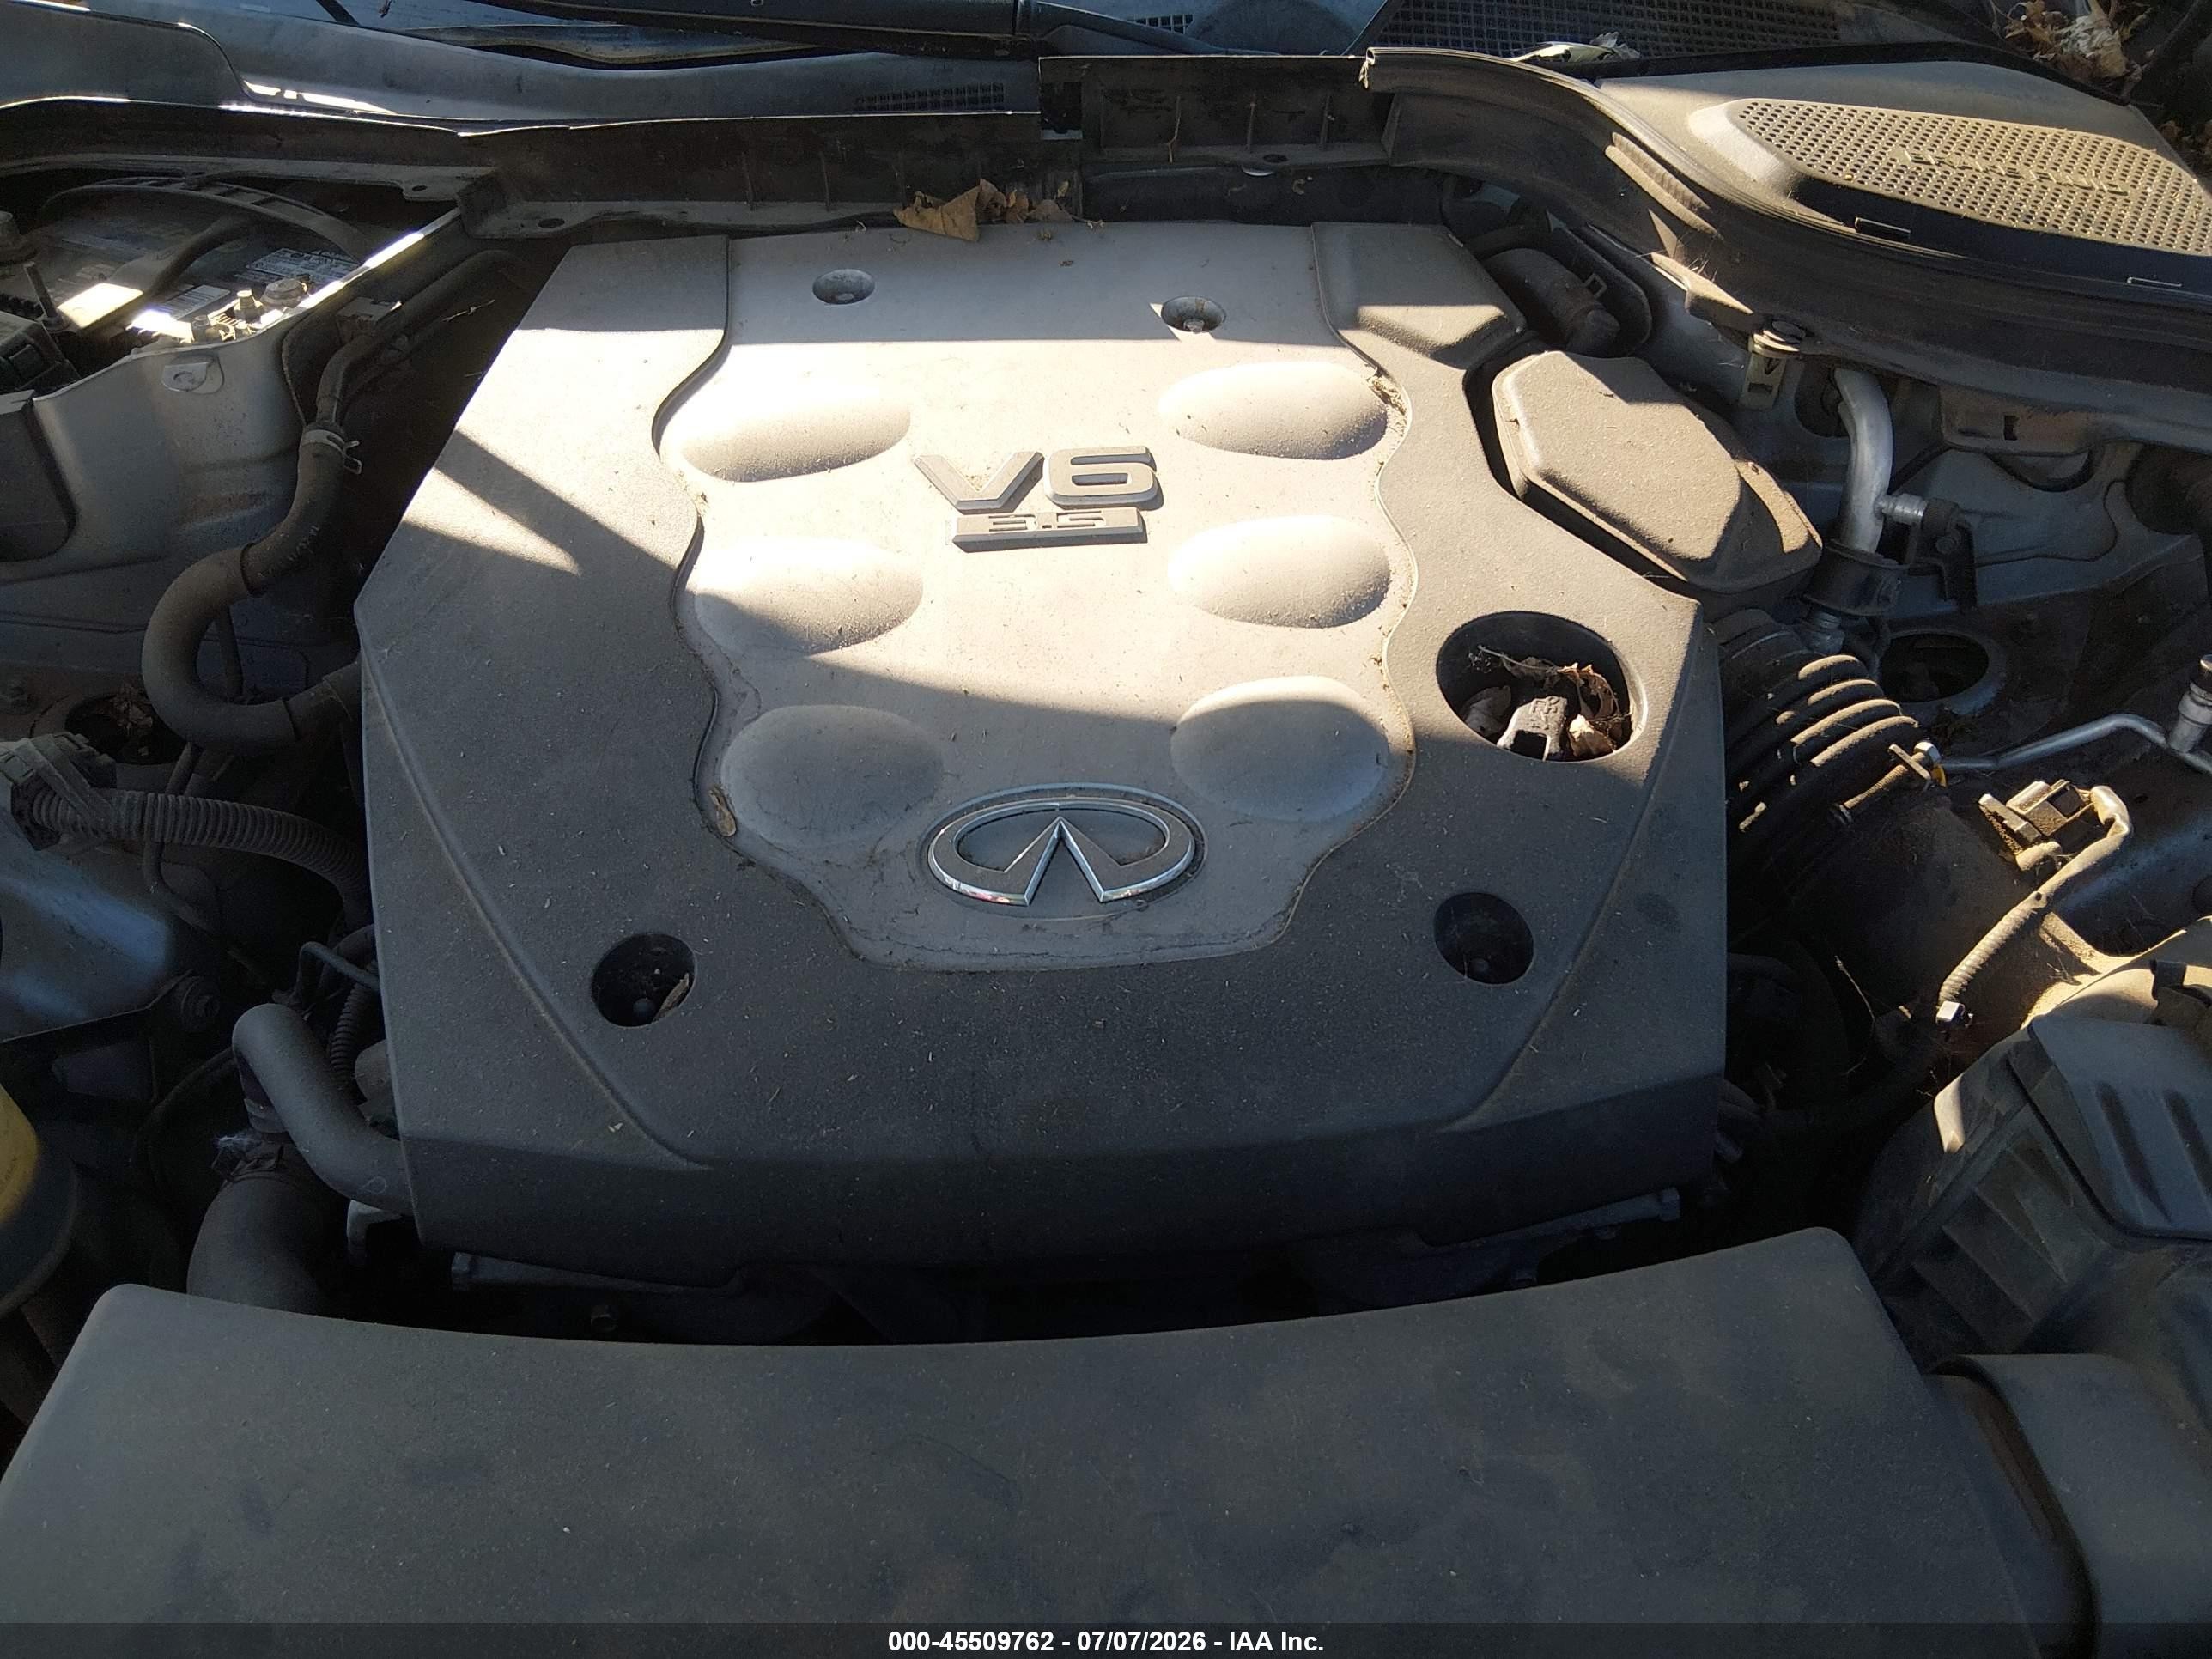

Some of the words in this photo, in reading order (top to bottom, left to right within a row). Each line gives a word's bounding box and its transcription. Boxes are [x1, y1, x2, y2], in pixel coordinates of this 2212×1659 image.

[1904, 149, 2024, 179] BRAKE
[2028, 168, 2130, 196] FLUID
[913, 446, 1162, 513] V6
[988, 511, 1107, 532] 3.5
